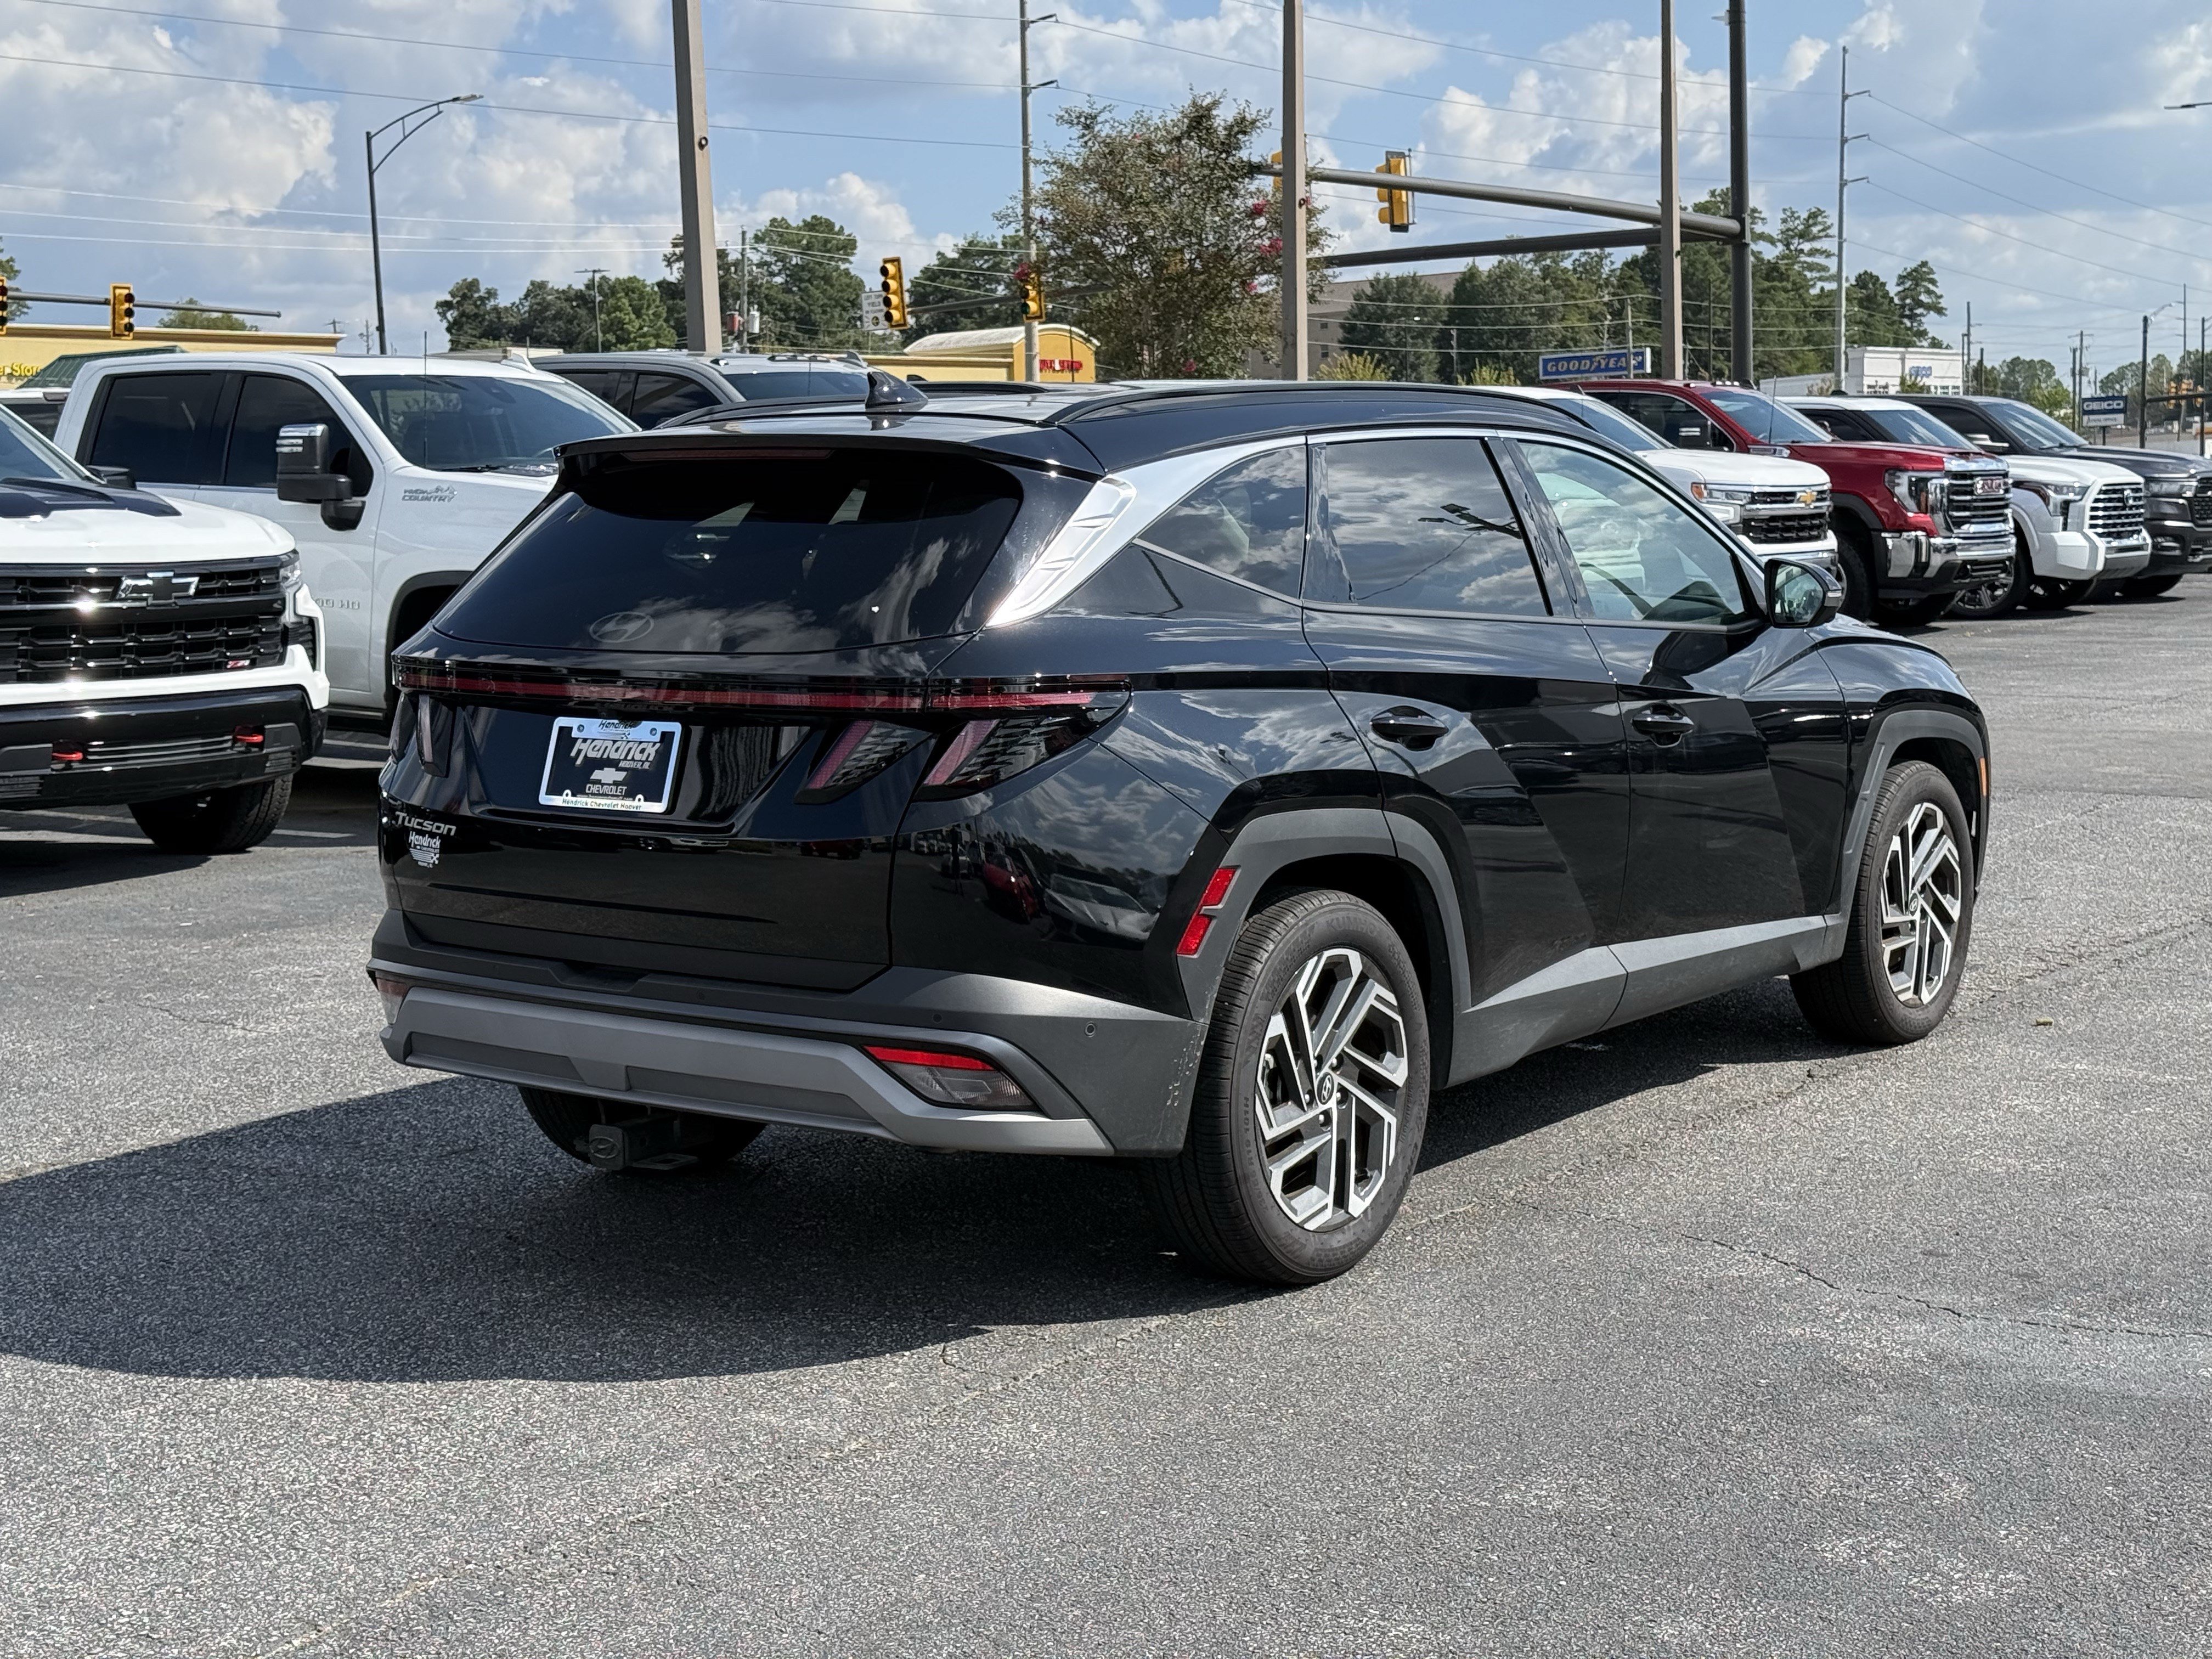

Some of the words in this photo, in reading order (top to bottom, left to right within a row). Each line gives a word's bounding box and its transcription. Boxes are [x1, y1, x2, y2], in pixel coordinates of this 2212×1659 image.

[1547, 356, 1638, 374] GOODYEA
[2084, 400, 2124, 411] GEICO
[570, 738, 661, 766] Hendrick
[586, 785, 628, 795] CHEVROLET
[562, 798, 589, 806] Hendrick
[590, 800, 619, 809] Chevrolet
[408, 831, 441, 848] Hendrick
[1326, 916, 1378, 937] KUMHO
